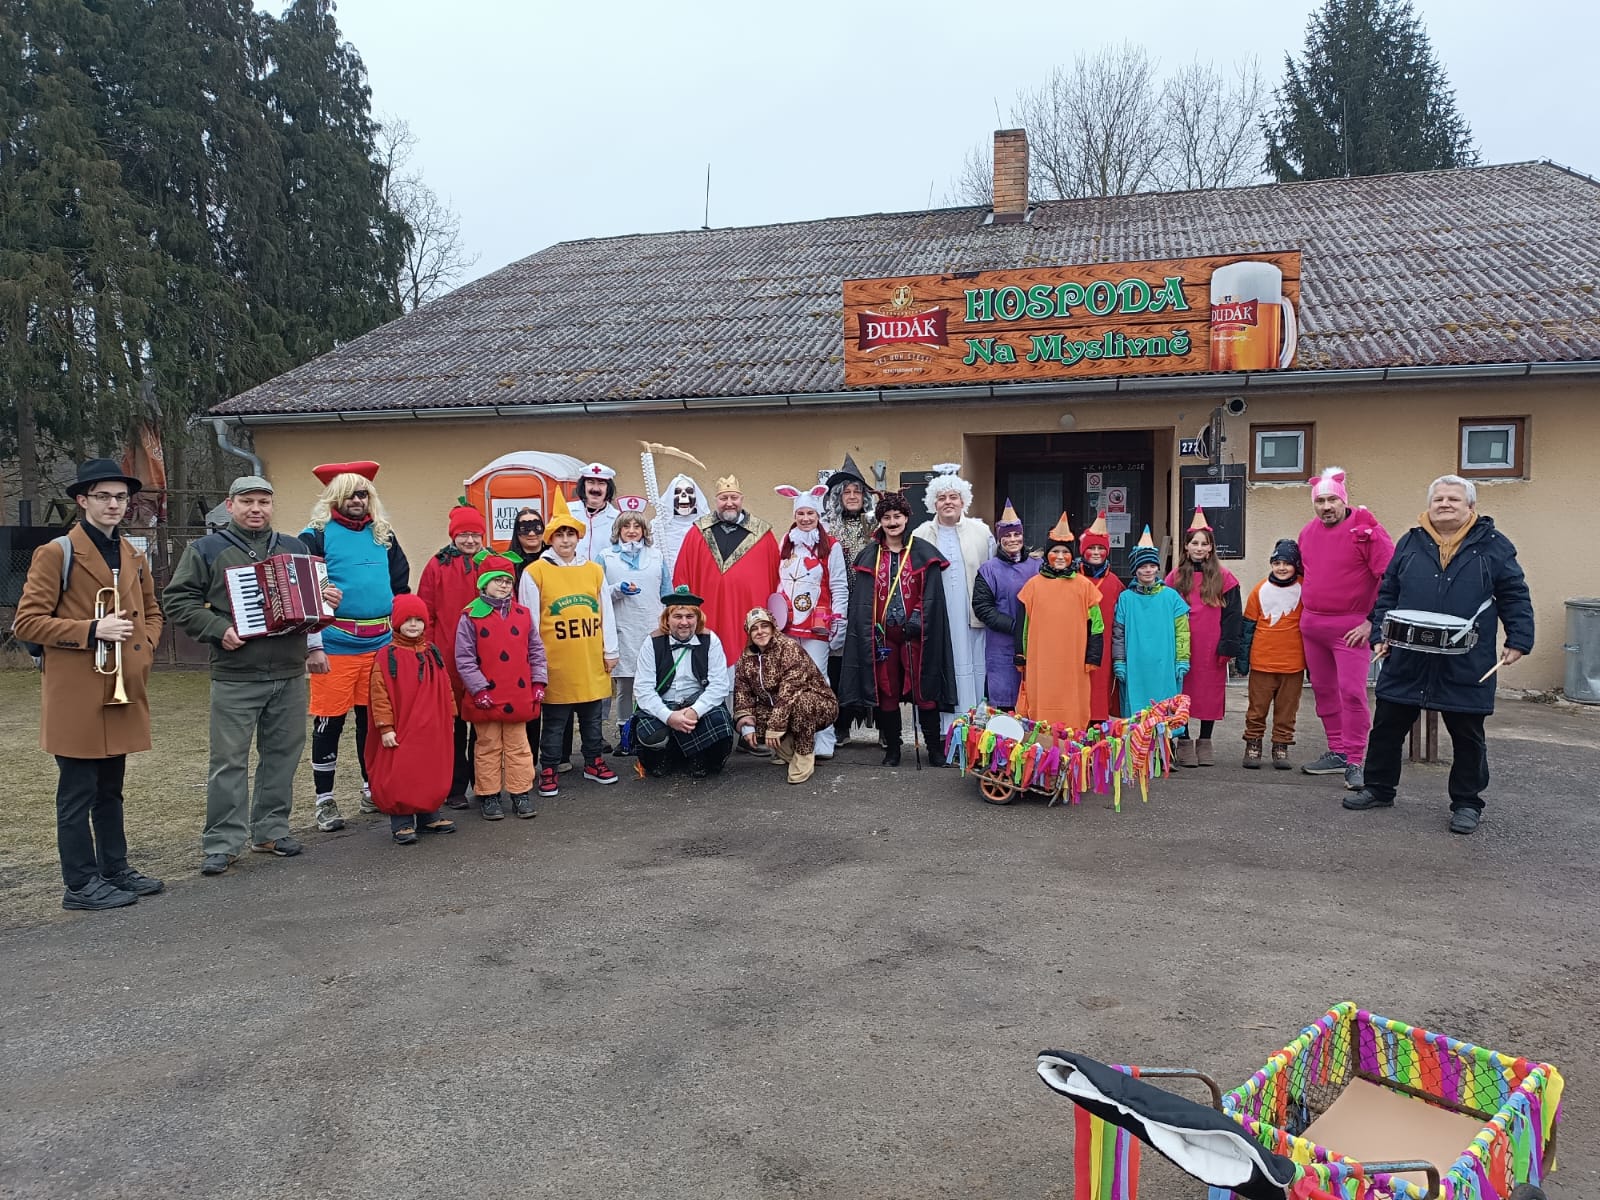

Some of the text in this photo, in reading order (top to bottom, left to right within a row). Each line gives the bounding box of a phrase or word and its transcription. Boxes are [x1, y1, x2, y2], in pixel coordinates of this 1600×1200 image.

[964, 276, 1189, 322] HOSPODA
[866, 317, 939, 340] DUDÁK
[962, 330, 1189, 365] Na Myslivně
[1181, 442, 1199, 453] 272
